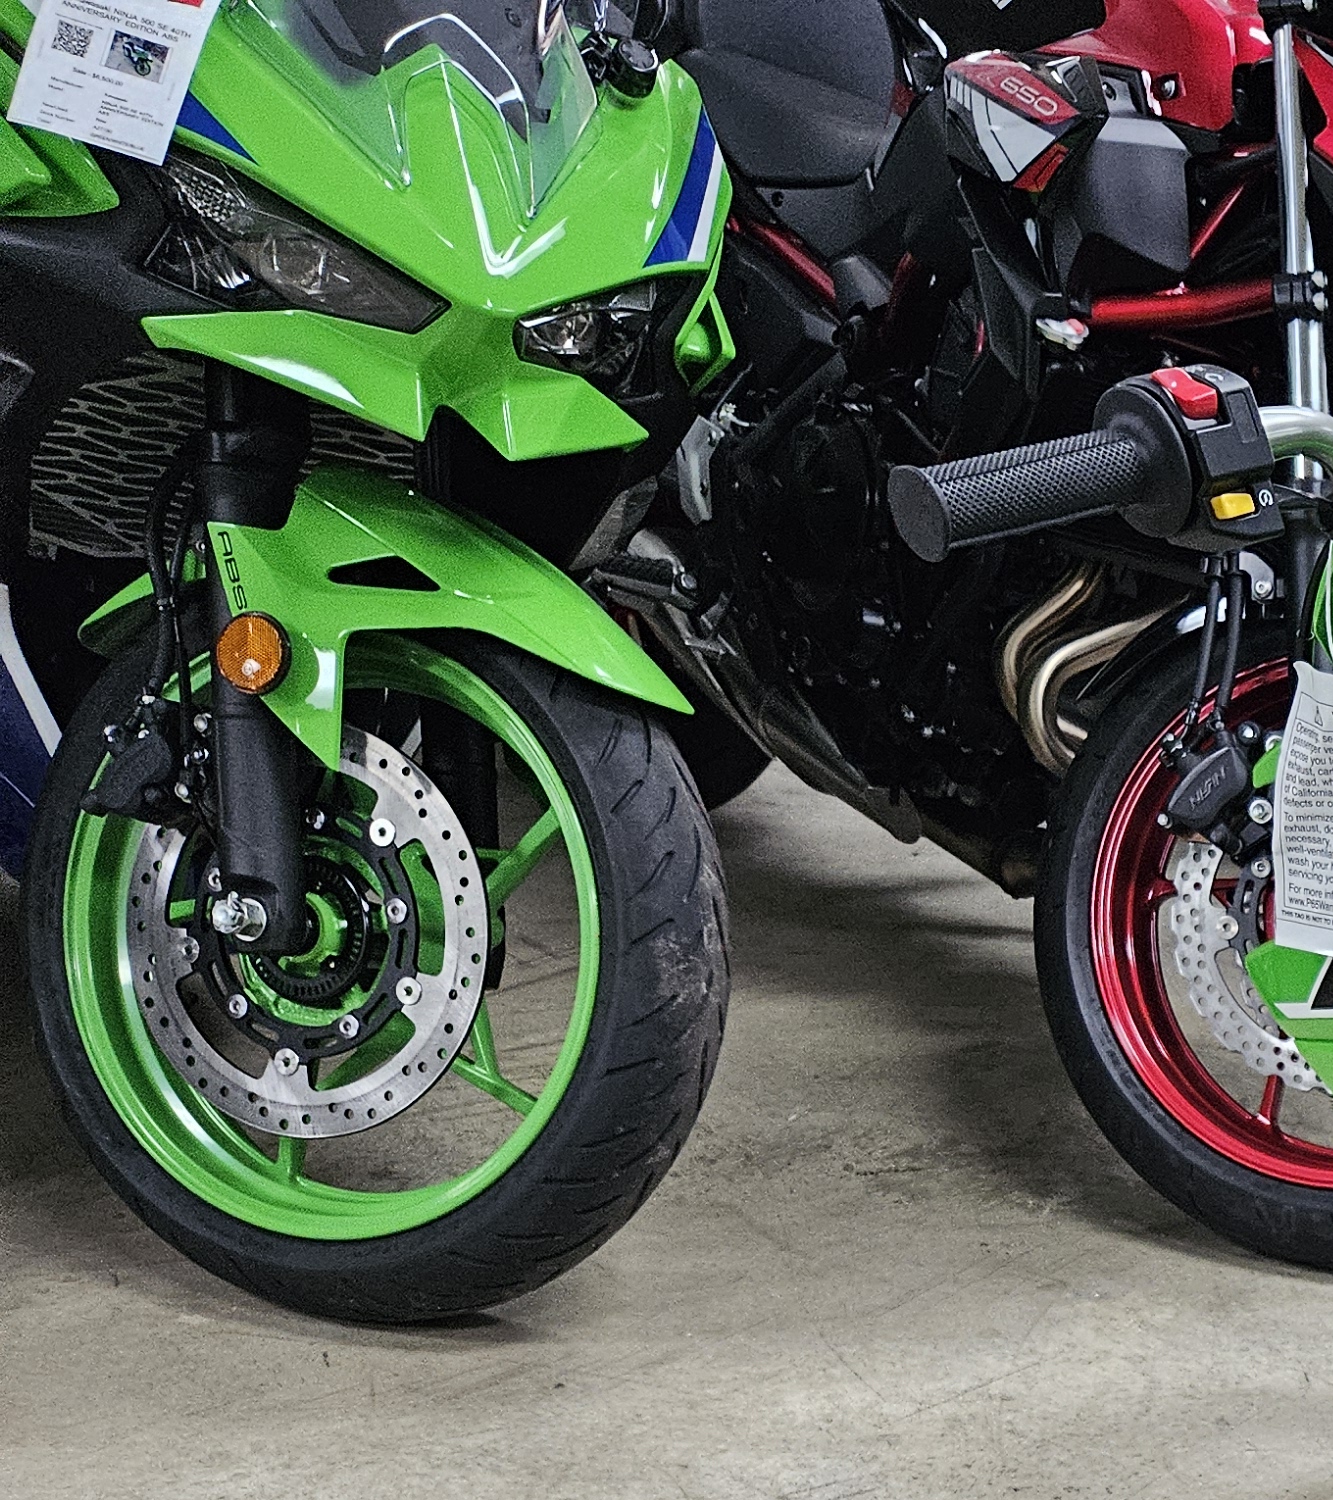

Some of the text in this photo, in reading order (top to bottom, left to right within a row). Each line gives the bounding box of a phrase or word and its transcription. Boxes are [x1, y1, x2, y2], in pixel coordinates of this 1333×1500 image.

[124, 20, 160, 37] EDITION
[1000, 75, 1058, 116] 650
[218, 531, 247, 610] ABS
[1310, 756, 1326, 768] you
[1298, 777, 1319, 787] lead,
[1292, 787, 1333, 798] California
[1284, 811, 1294, 822] To
[1284, 823, 1321, 834] exhaust,
[1285, 834, 1332, 849] necessary,
[1287, 856, 1309, 867] wash
[1311, 859, 1329, 871] your
[1288, 868, 1323, 884] servicing
[1288, 882, 1302, 893] For
[1303, 888, 1323, 898] more
[1281, 909, 1293, 917] THIS
[1294, 912, 1305, 920] TAG
